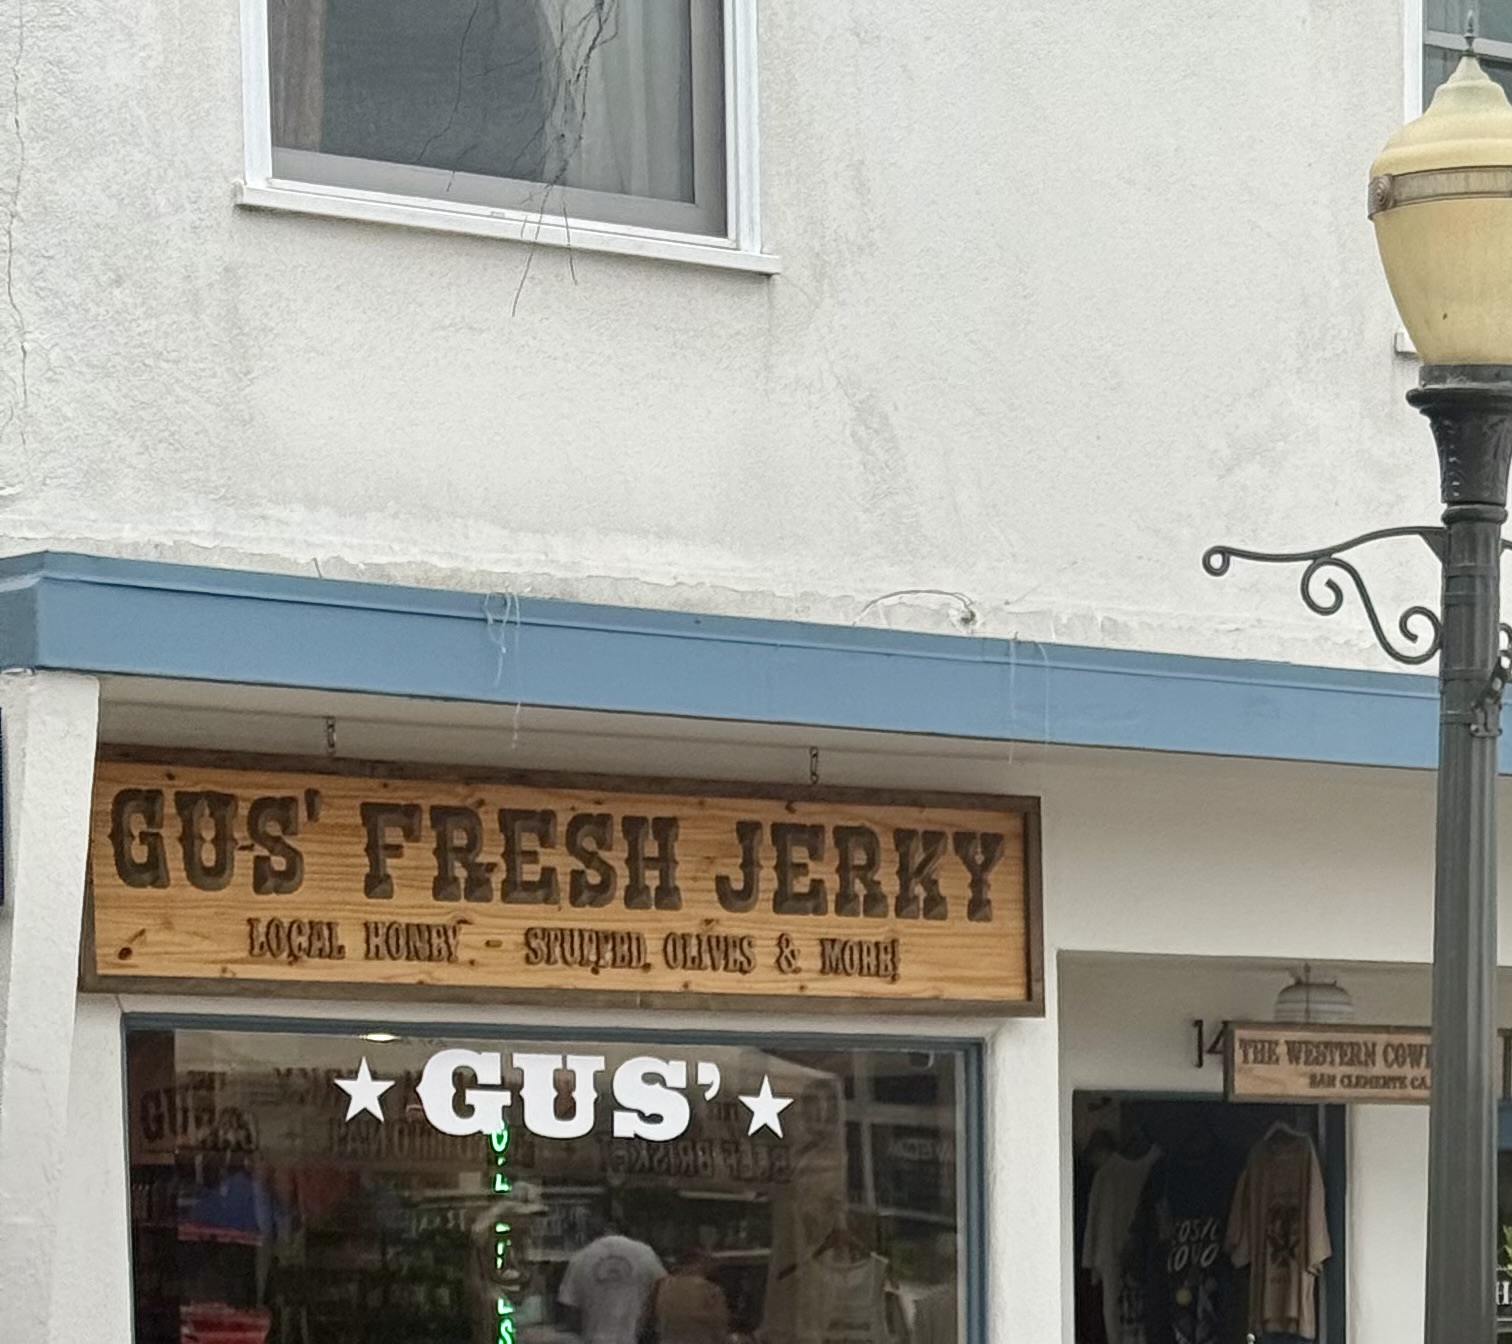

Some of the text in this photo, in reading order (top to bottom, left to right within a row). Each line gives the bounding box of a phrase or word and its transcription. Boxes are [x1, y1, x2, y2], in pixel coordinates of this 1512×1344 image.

[108, 787, 1006, 923] GUS' FRESH JERKY
[246, 917, 346, 961] LOCAL
[363, 921, 463, 963] HONEY
[524, 926, 649, 969] STUFFED
[664, 931, 756, 975] OLIVES
[775, 932, 801, 975] &
[818, 937, 901, 983] MORE!
[1238, 1037, 1280, 1066] THE
[1286, 1040, 1377, 1069] WESTERN
[1309, 1073, 1338, 1090] SAN
[1340, 1074, 1408, 1091] CLEMENTE
[415, 1048, 720, 1142] GUS'
